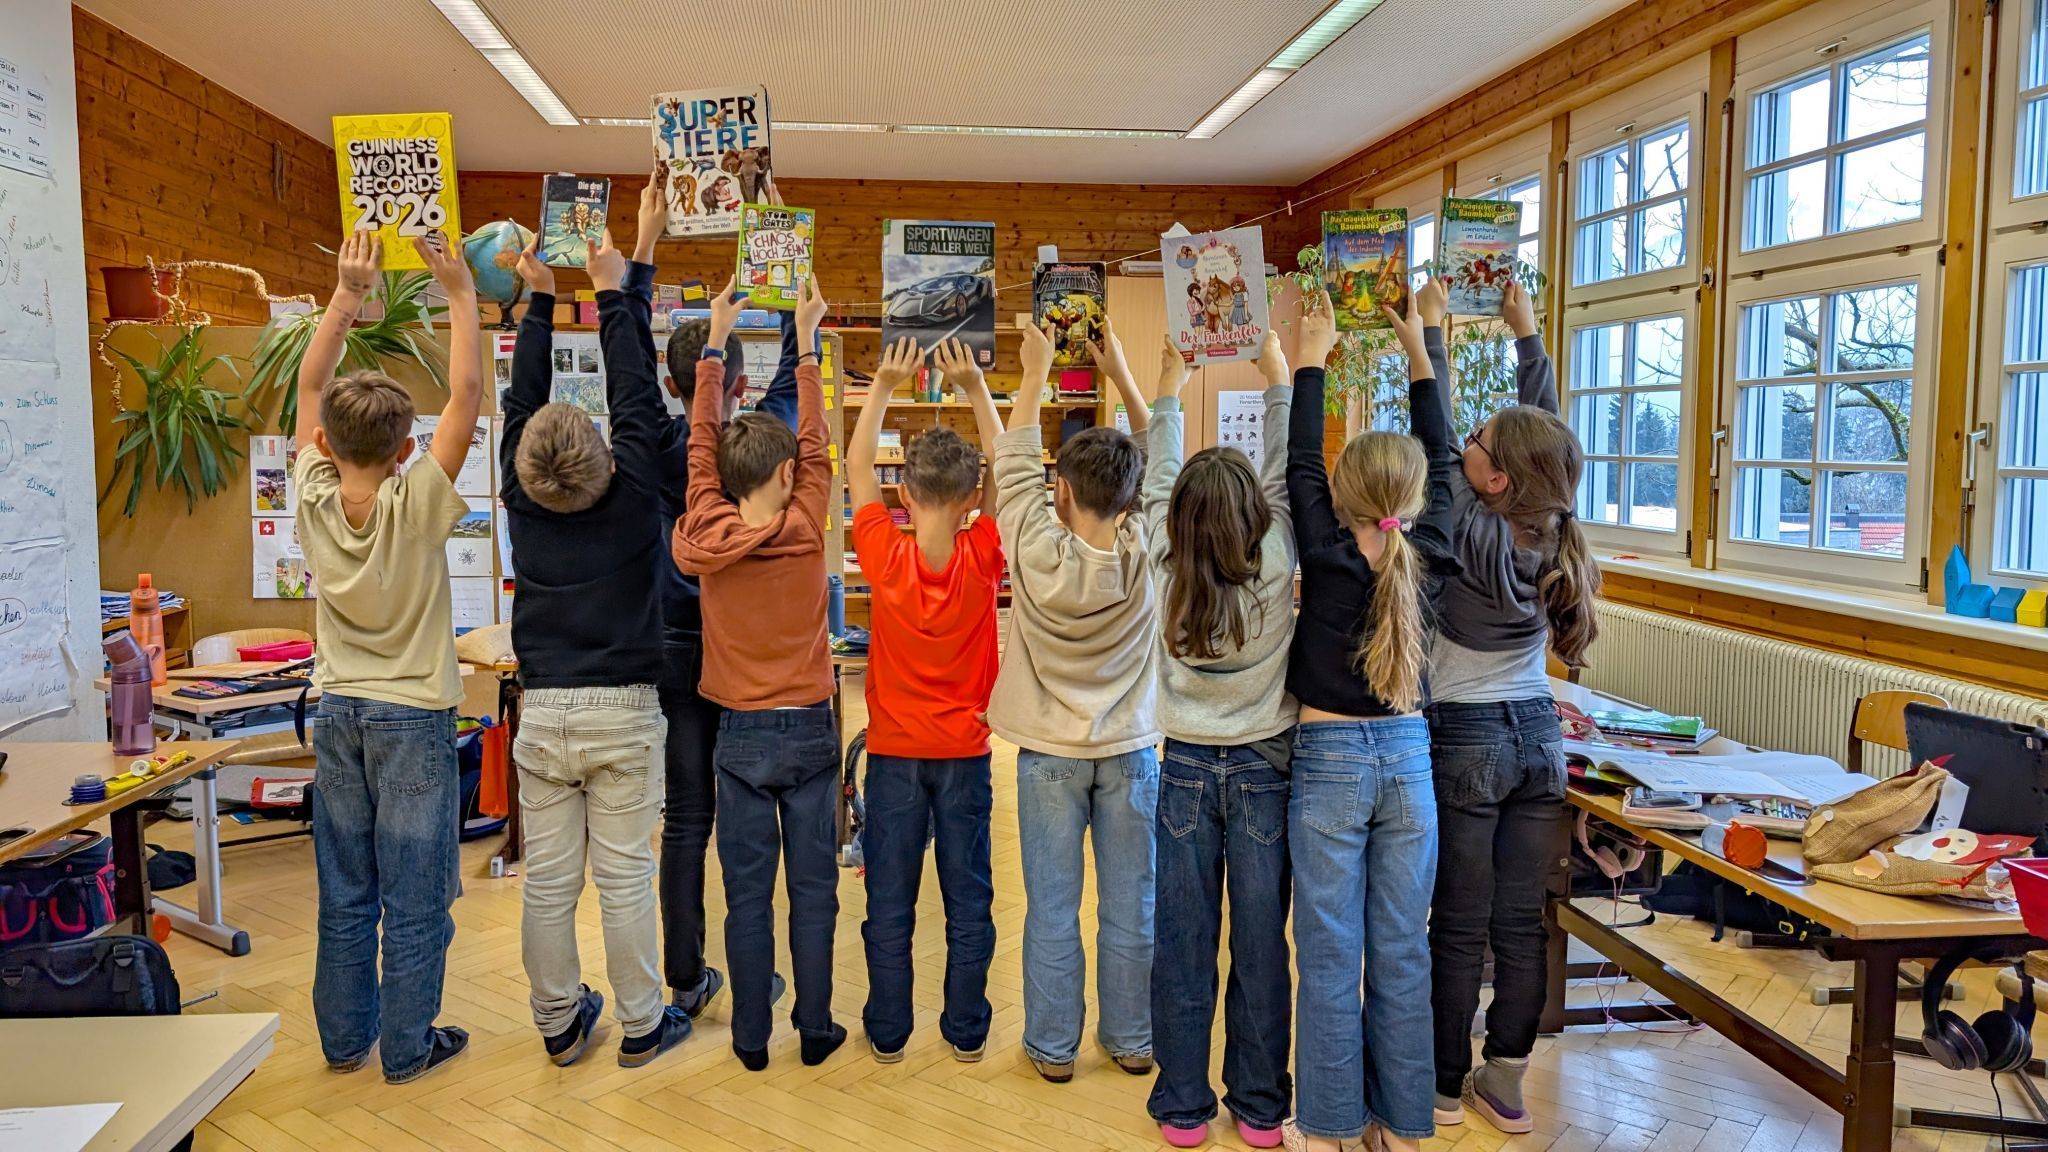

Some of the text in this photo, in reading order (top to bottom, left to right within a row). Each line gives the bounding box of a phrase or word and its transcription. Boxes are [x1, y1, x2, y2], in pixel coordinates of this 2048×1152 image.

[658, 96, 758, 132] SUPER
[347, 136, 439, 156] GUINNESS
[660, 125, 759, 160] TIERE
[348, 152, 443, 177] WORLD
[349, 174, 445, 195] RECORDS
[577, 181, 603, 191] Die drei
[1459, 208, 1496, 218] Baumhaus
[1462, 203, 1492, 211] magische
[352, 192, 447, 238] 2026
[766, 211, 789, 221] TOM
[1330, 214, 1375, 225] Das magische
[763, 218, 792, 229] GATES
[1340, 222, 1379, 231] Baumhaus
[1461, 225, 1499, 233] Lawinenhunde
[754, 232, 795, 248] CHAOS
[906, 227, 991, 242] SPORTWAGEN
[1357, 238, 1370, 246] dem
[1371, 237, 1385, 246] Pfad
[752, 244, 805, 261] HOCH ZEHN
[907, 242, 991, 255] AUS ALLER WELT
[1037, 271, 1103, 294] PHANTOMIAS
[1180, 324, 1262, 344] Der Funkenfels
[17, 391, 58, 409] zum Schluss
